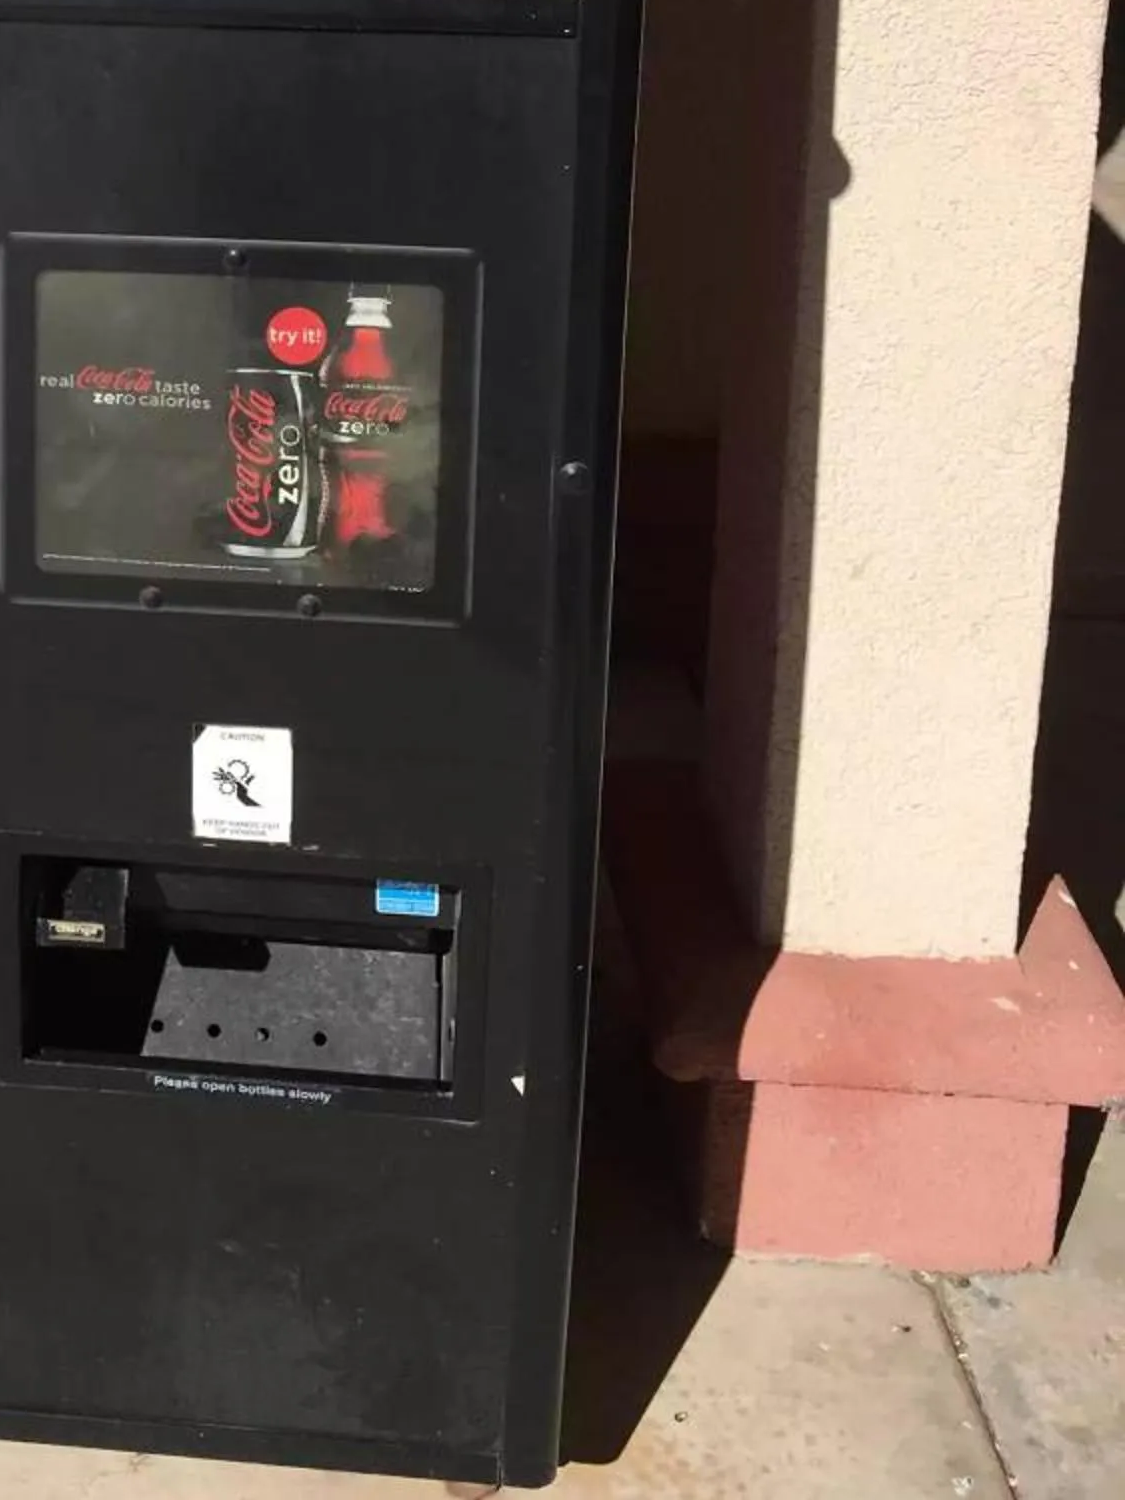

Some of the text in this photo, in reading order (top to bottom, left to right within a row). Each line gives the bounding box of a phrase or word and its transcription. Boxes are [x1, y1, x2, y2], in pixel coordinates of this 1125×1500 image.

[269, 327, 322, 346] try it!
[39, 374, 74, 388] real
[155, 380, 201, 395] taste
[92, 391, 212, 410] zero calories
[338, 420, 391, 436] zero
[226, 384, 277, 536] Coca-Cola
[278, 425, 301, 505] zero
[154, 1075, 332, 1104] Please open bottles slowly
